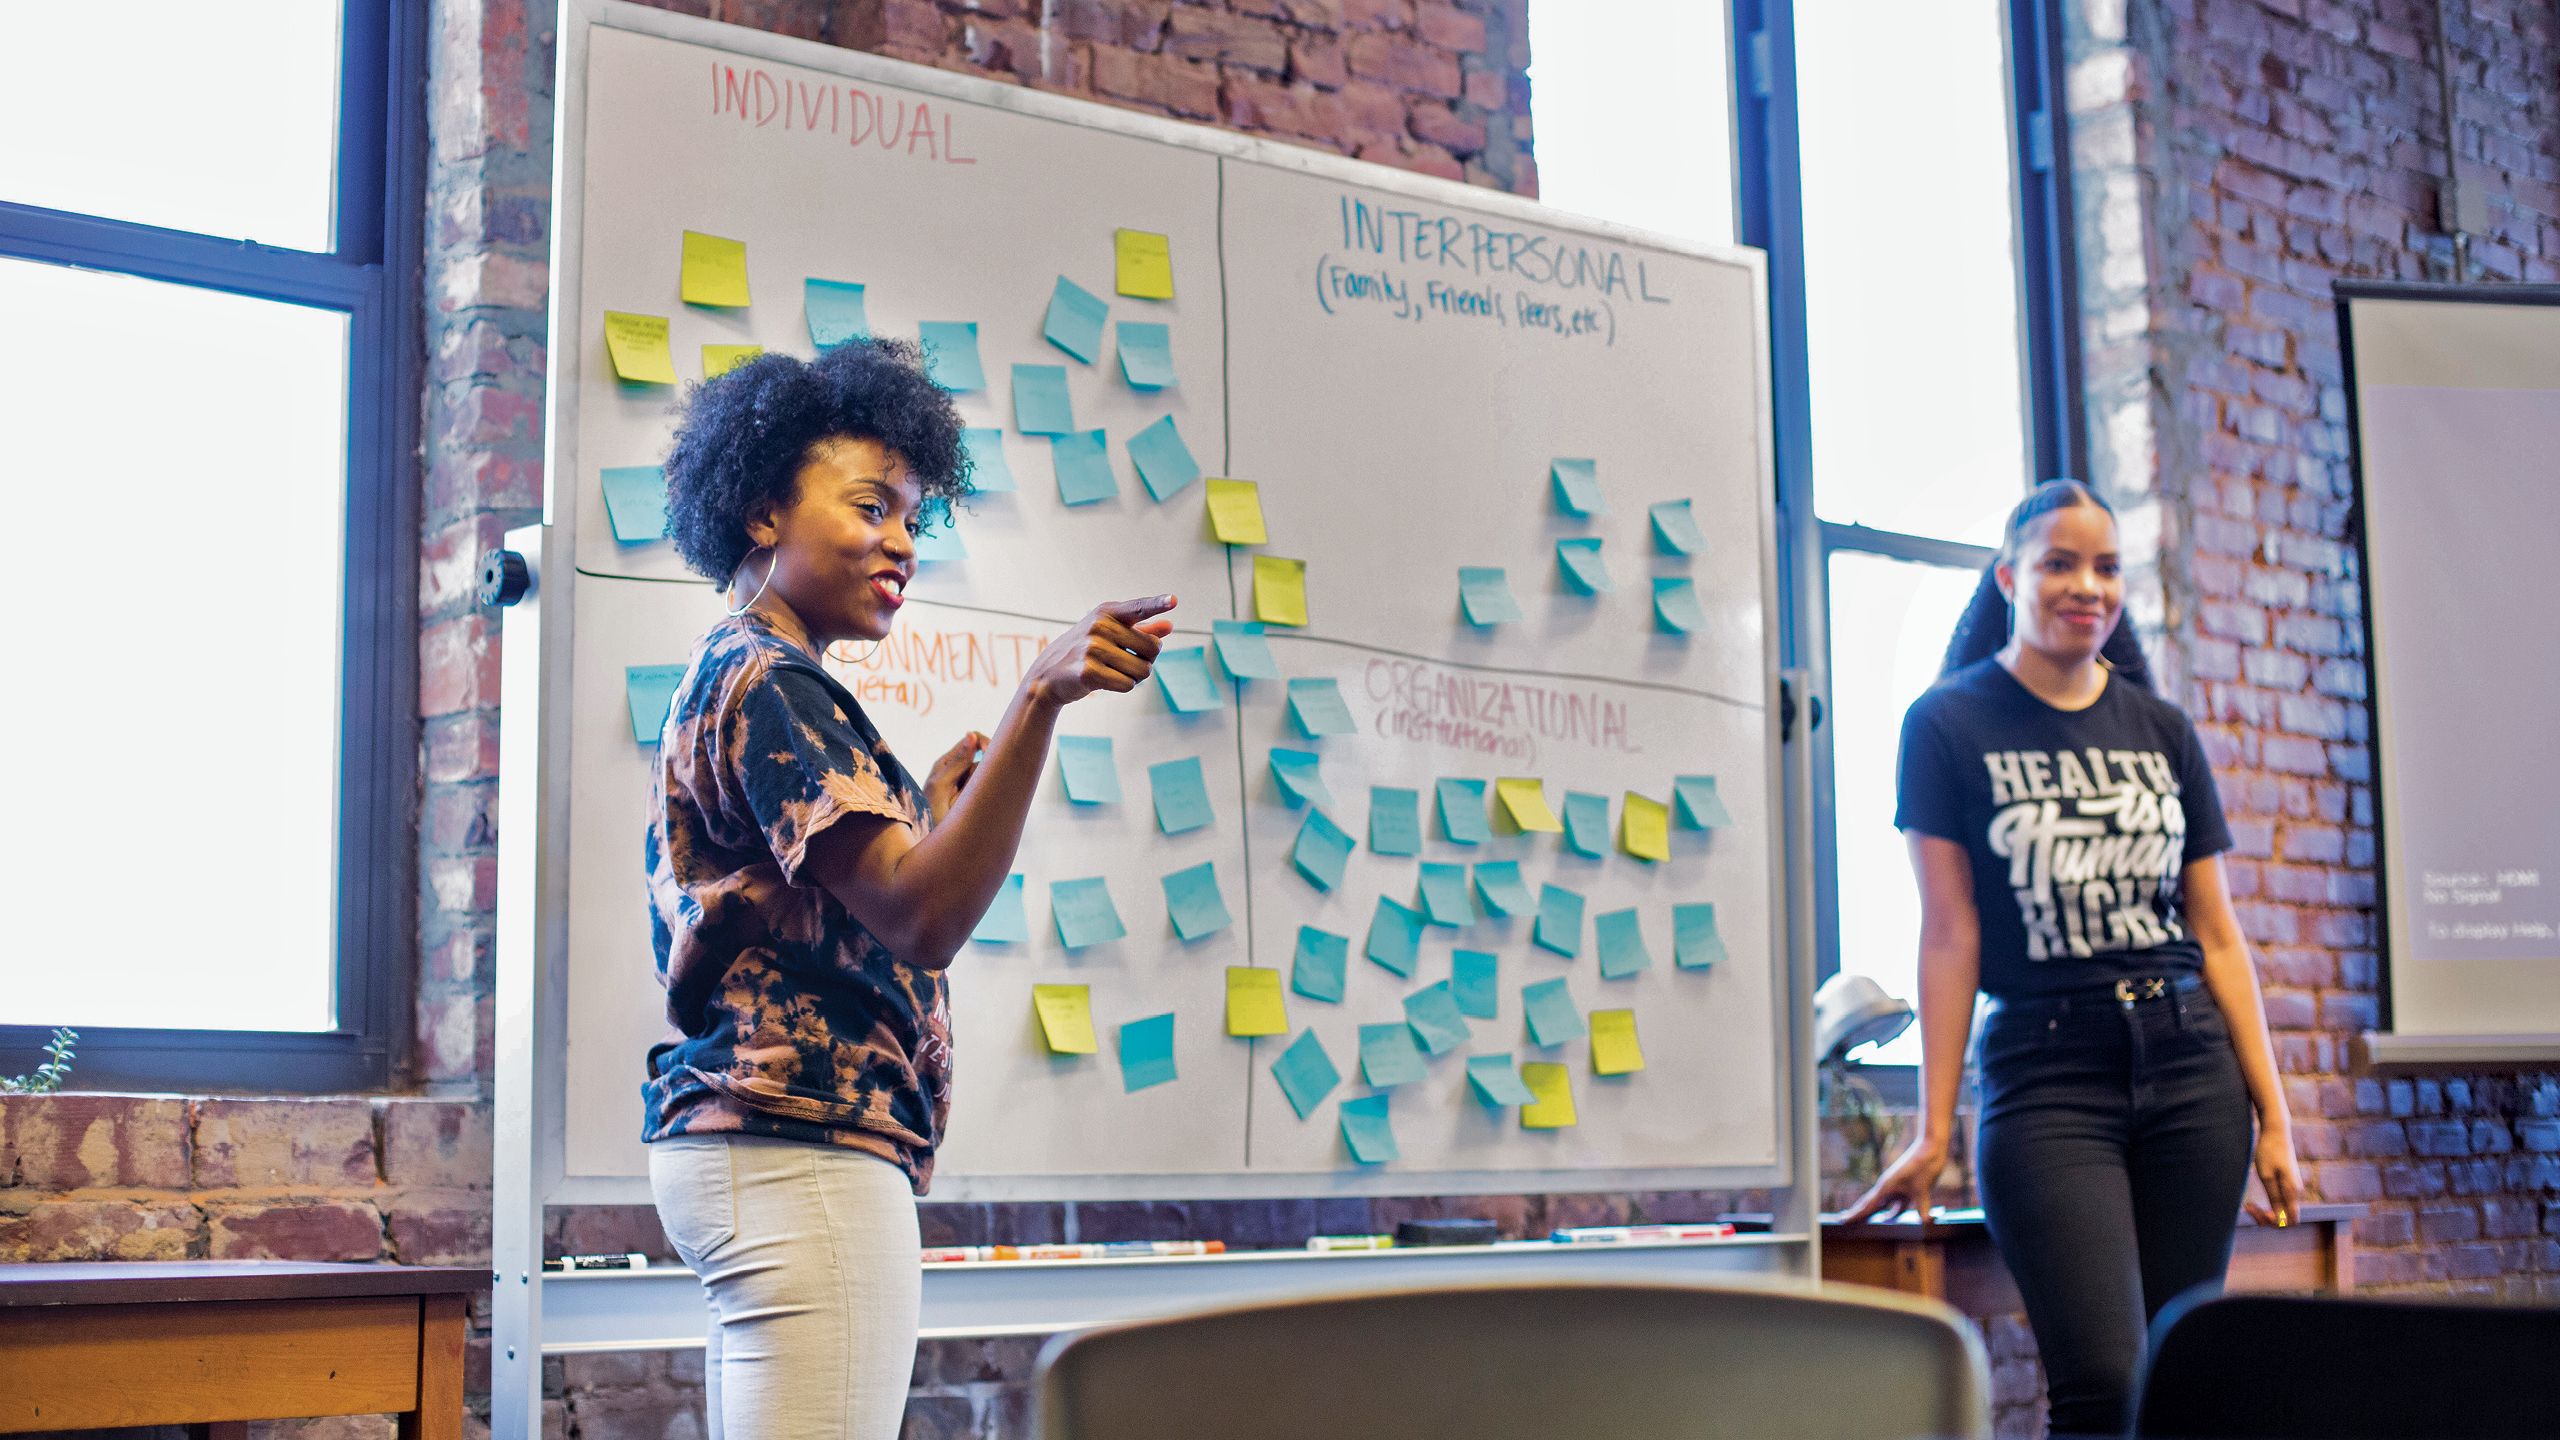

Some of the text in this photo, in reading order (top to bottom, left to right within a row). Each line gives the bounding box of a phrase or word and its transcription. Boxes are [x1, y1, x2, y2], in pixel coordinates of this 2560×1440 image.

[712, 61, 978, 165] INDIVIDUAL
[1341, 194, 1672, 305] INTERPERSONAL
[1364, 657, 1644, 754] ORGANIZATIONAL
[1984, 746, 2181, 807] HEALTH
[1987, 799, 2186, 904] Human
